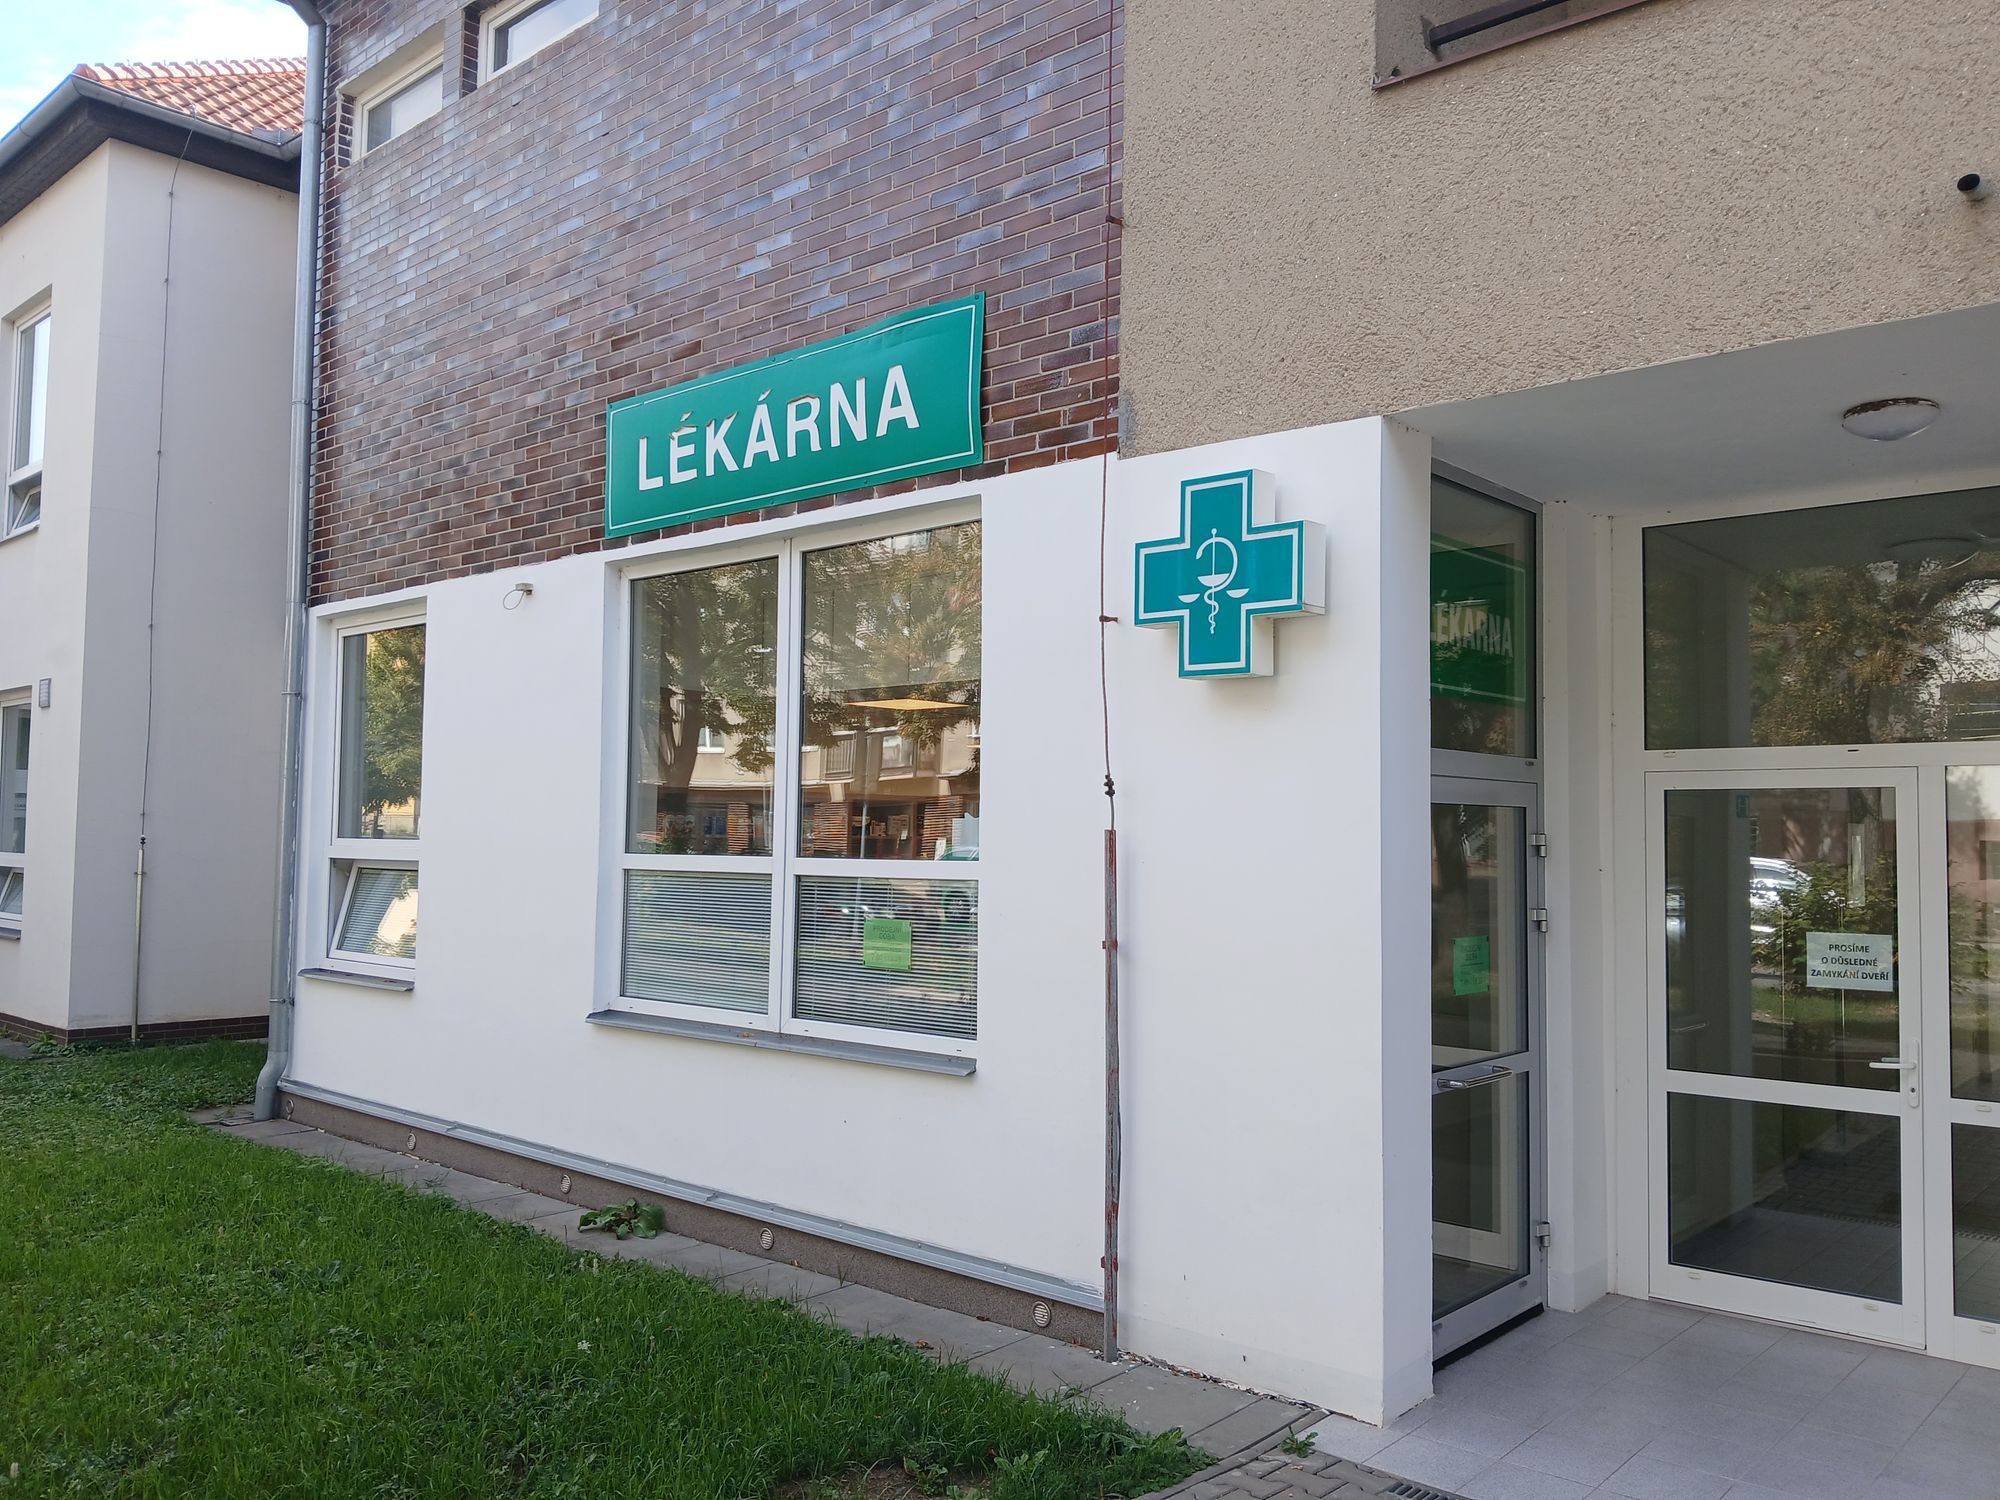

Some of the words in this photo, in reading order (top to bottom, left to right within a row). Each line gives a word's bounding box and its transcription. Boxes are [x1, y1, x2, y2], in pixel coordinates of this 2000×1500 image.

[638, 364, 920, 491] LÉKÁRNA
[1828, 942, 1870, 953] PROSÍME
[1821, 956, 1829, 965] O
[1830, 955, 1878, 967] DŮSLEDNÉ
[1810, 968, 1860, 980] ZAMYKÁNÍ
[1861, 971, 1889, 981] DVEŘÍ
